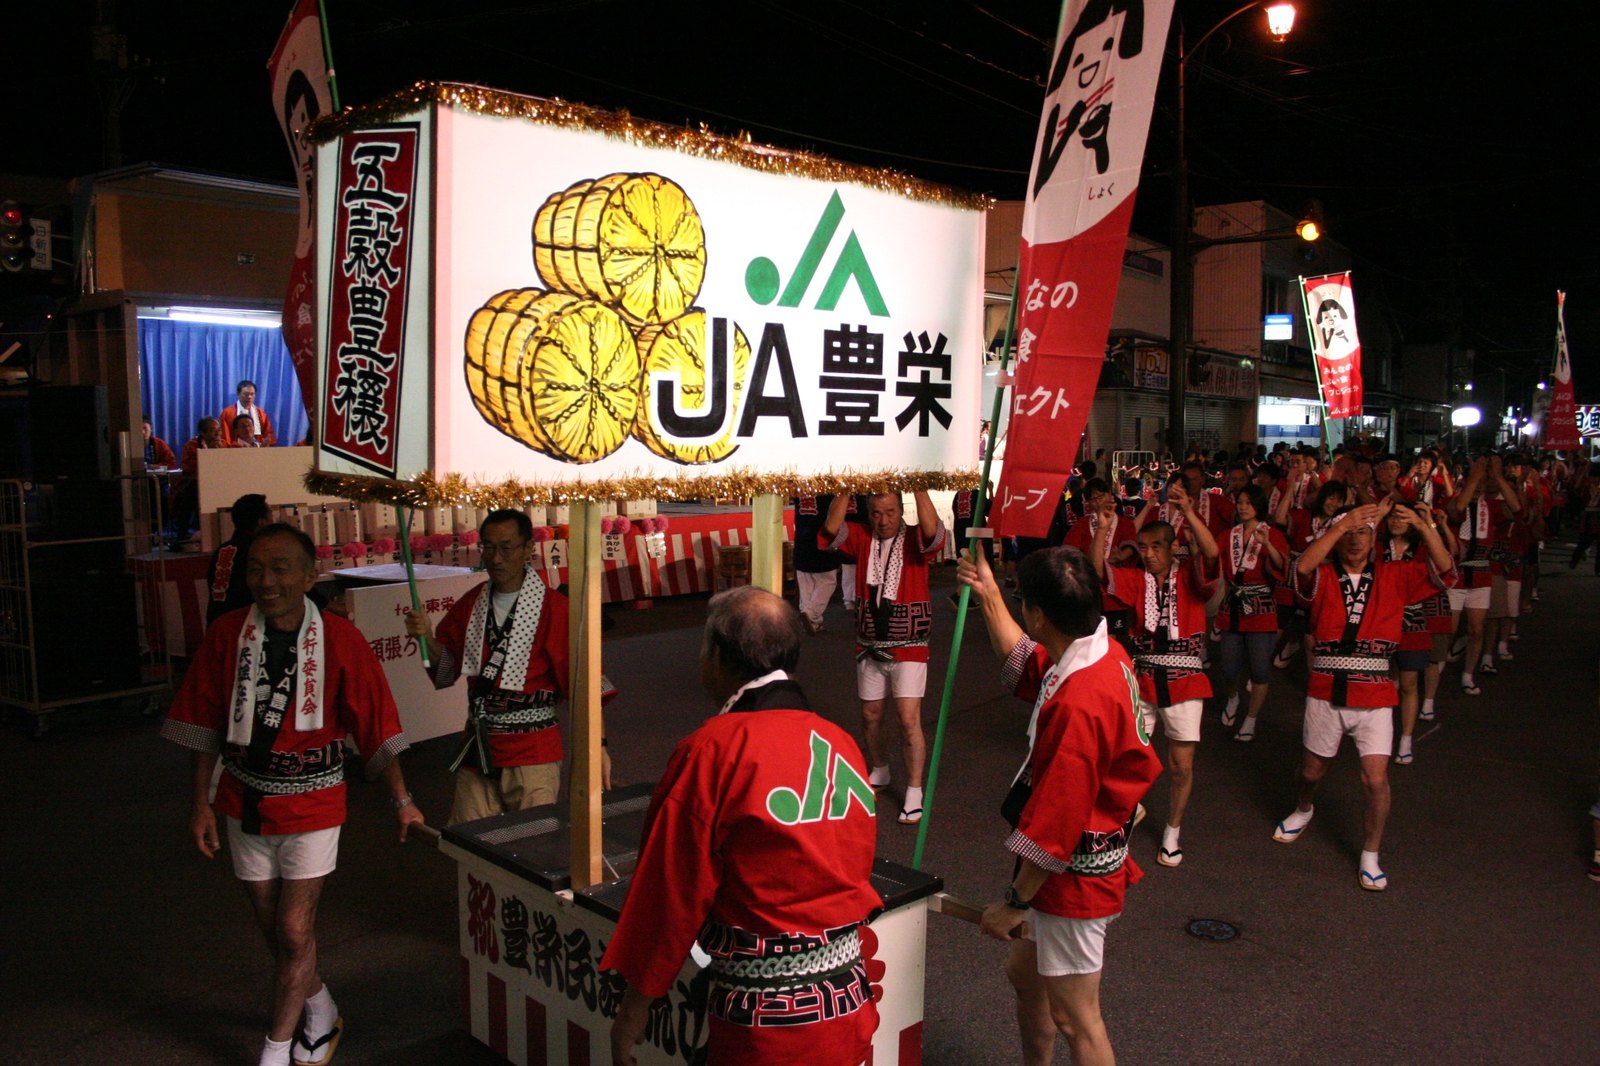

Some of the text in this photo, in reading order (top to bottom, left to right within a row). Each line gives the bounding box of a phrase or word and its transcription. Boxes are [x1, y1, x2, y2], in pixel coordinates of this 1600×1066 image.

[1088, 182, 1116, 201] しょく
[332, 142, 407, 455] 五穀豊穣
[657, 317, 954, 438] JA豊栄
